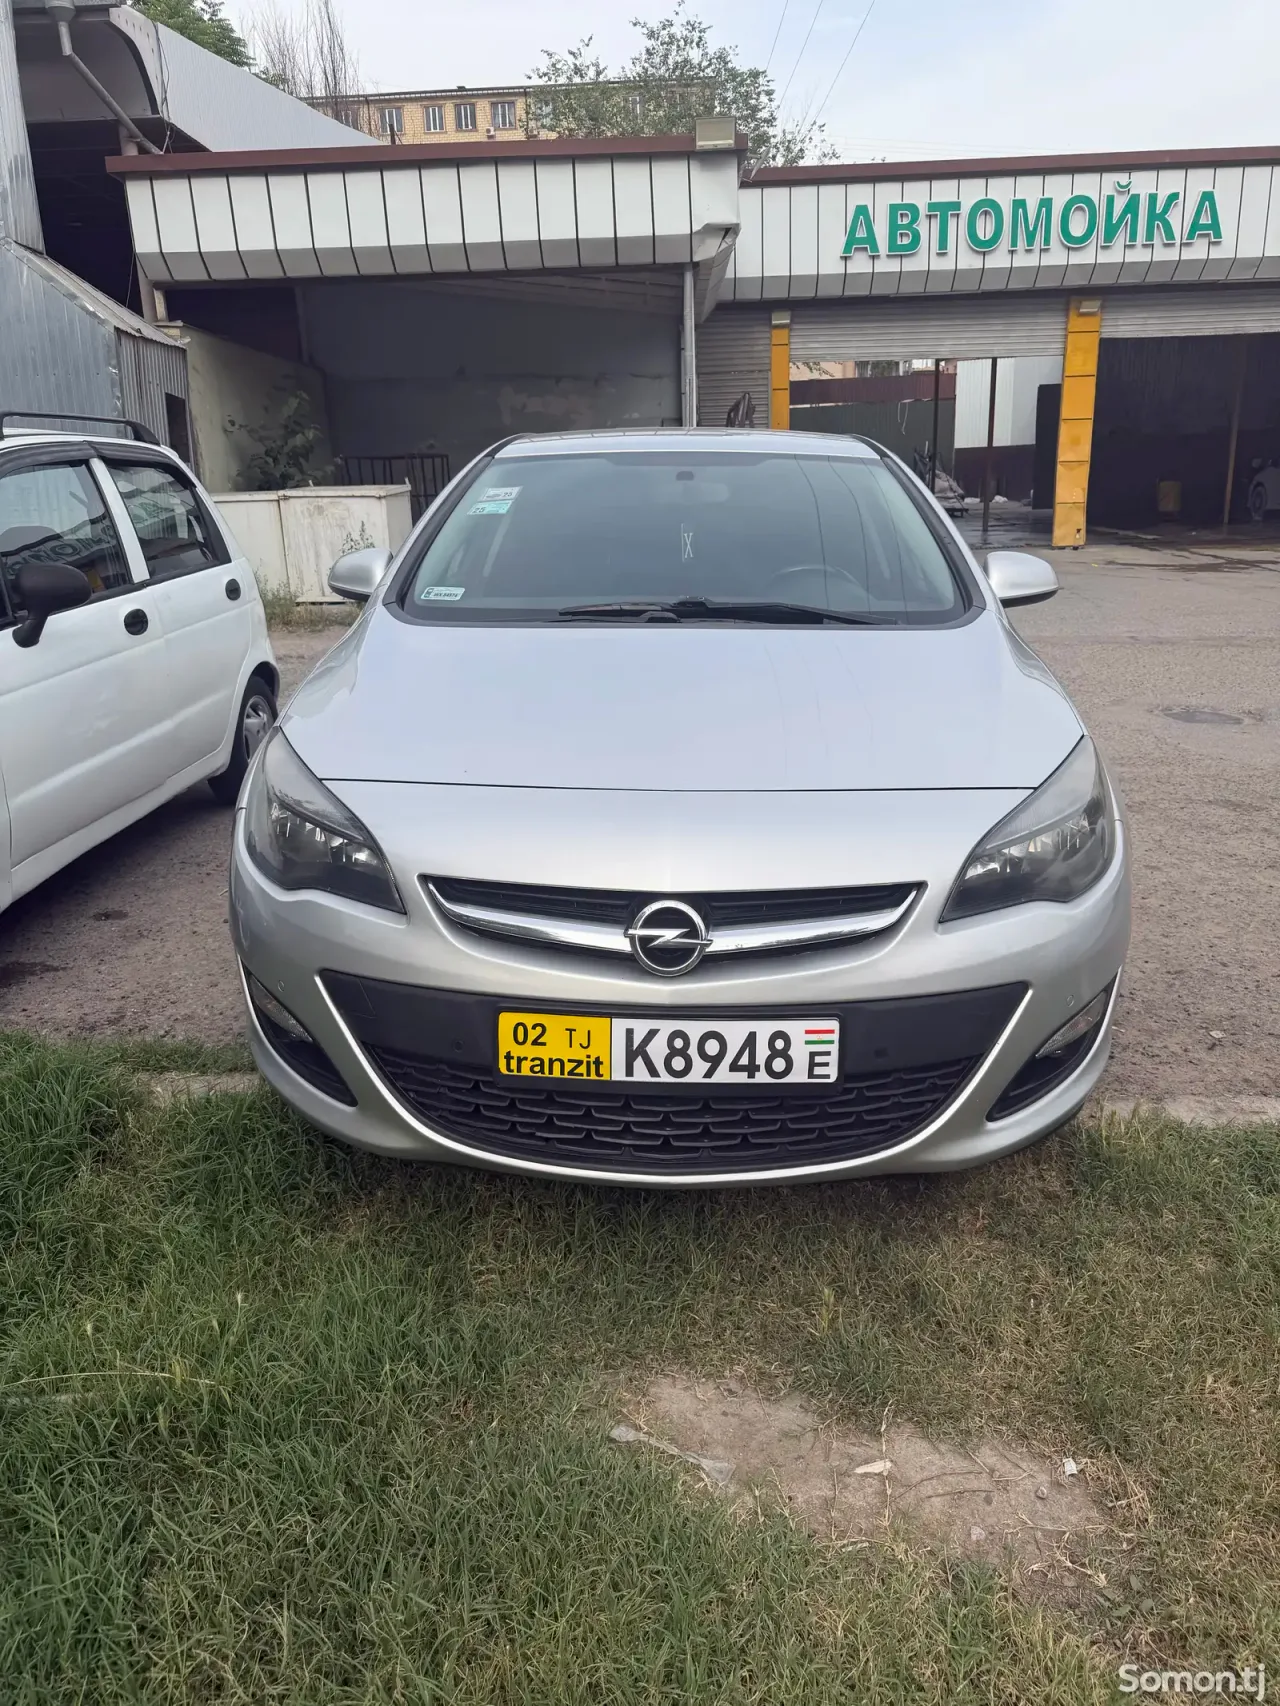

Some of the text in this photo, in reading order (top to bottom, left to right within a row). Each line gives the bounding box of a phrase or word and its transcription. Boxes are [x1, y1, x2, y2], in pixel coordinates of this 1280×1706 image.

[841, 180, 1224, 257] АВТОМОЙКА
[512, 1022, 591, 1050] 02 TJ
[503, 1050, 604, 1078] tranzit
[625, 1028, 794, 1080] K8948
[807, 1051, 832, 1080] E
